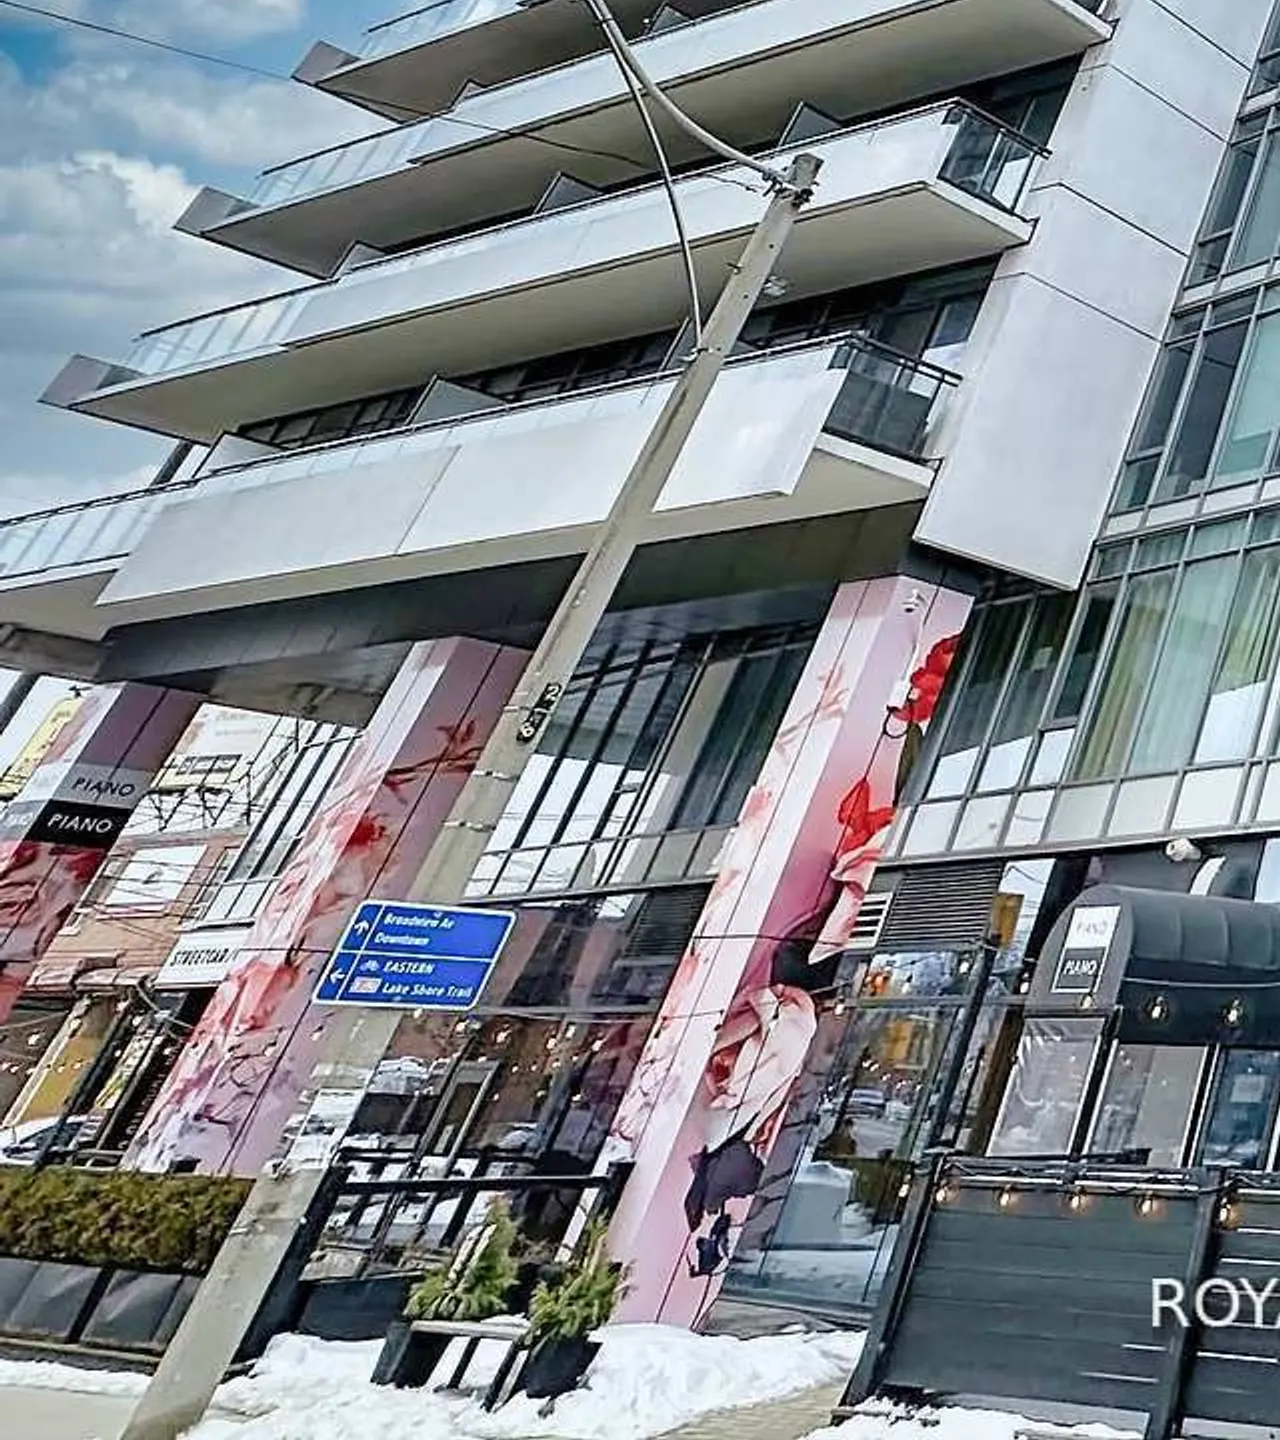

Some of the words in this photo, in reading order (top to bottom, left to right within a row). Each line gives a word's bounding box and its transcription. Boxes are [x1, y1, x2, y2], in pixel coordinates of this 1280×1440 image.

[72, 778, 136, 796] PIANO
[47, 813, 112, 833] PIANO
[375, 933, 430, 946] Downtown
[383, 960, 435, 975] EASTERN
[381, 982, 411, 995] Lake
[446, 985, 474, 998] Trail
